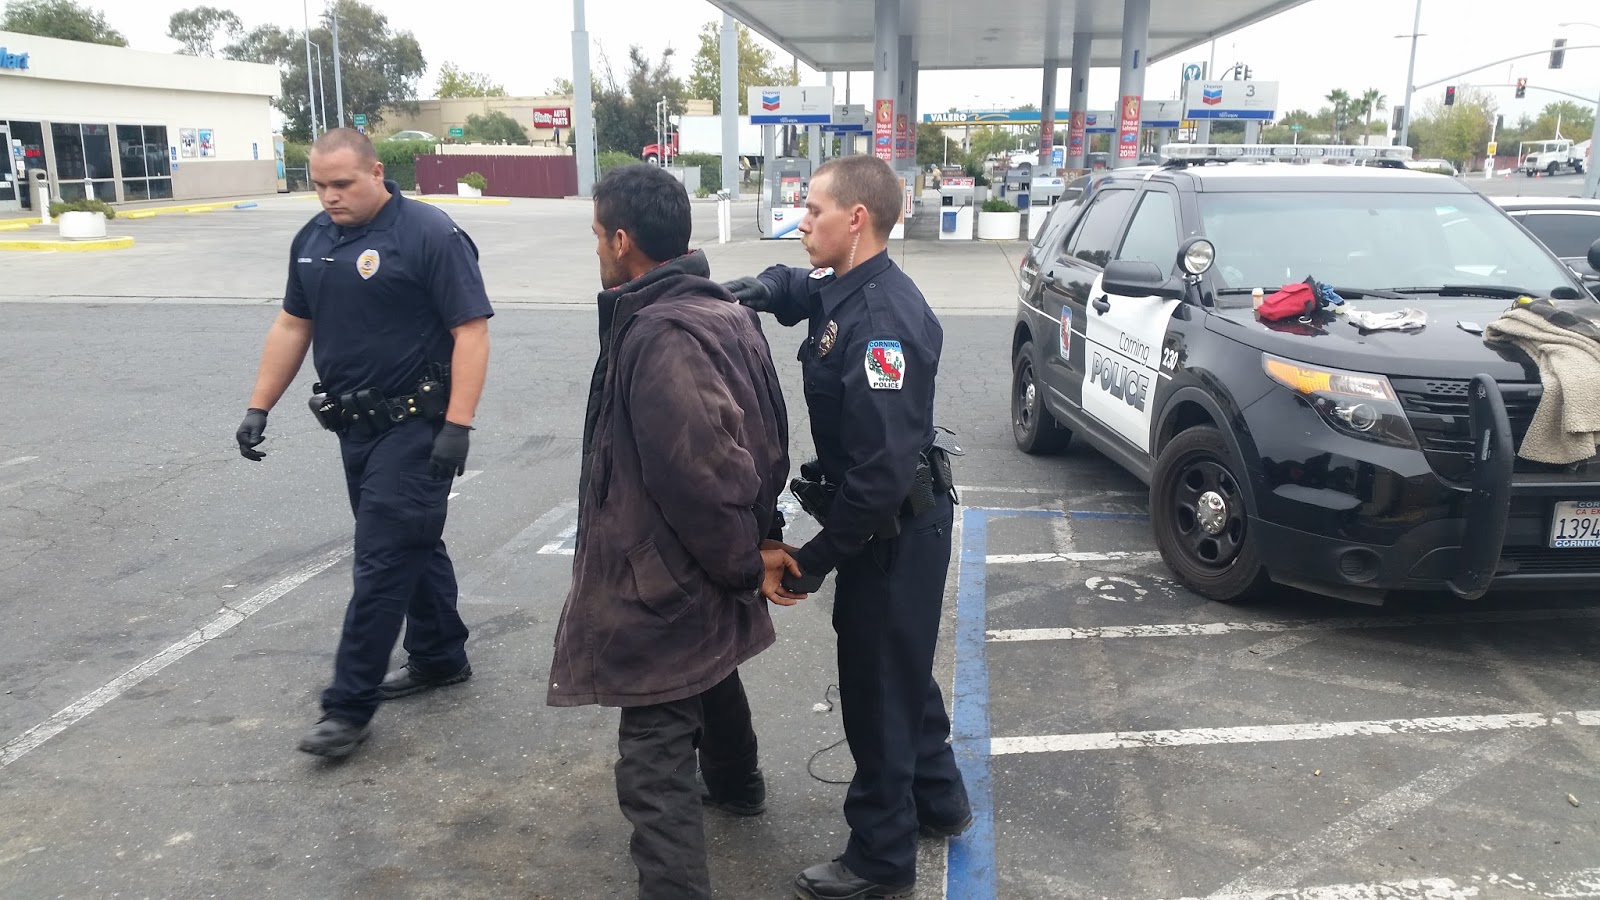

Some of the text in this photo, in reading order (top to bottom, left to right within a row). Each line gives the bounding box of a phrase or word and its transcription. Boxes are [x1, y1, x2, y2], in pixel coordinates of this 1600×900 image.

[801, 90, 807, 102] 1
[1245, 85, 1256, 97] 3
[553, 109, 567, 118] AUTO
[842, 107, 849, 116] 5
[1158, 103, 1165, 112] 7
[552, 117, 569, 126] PARTS
[931, 113, 967, 121] VALERO
[1119, 331, 1150, 366] Corning
[1162, 347, 1179, 371] 230
[1090, 351, 1150, 412] POLICE
[1556, 518, 1600, 539] 1394
